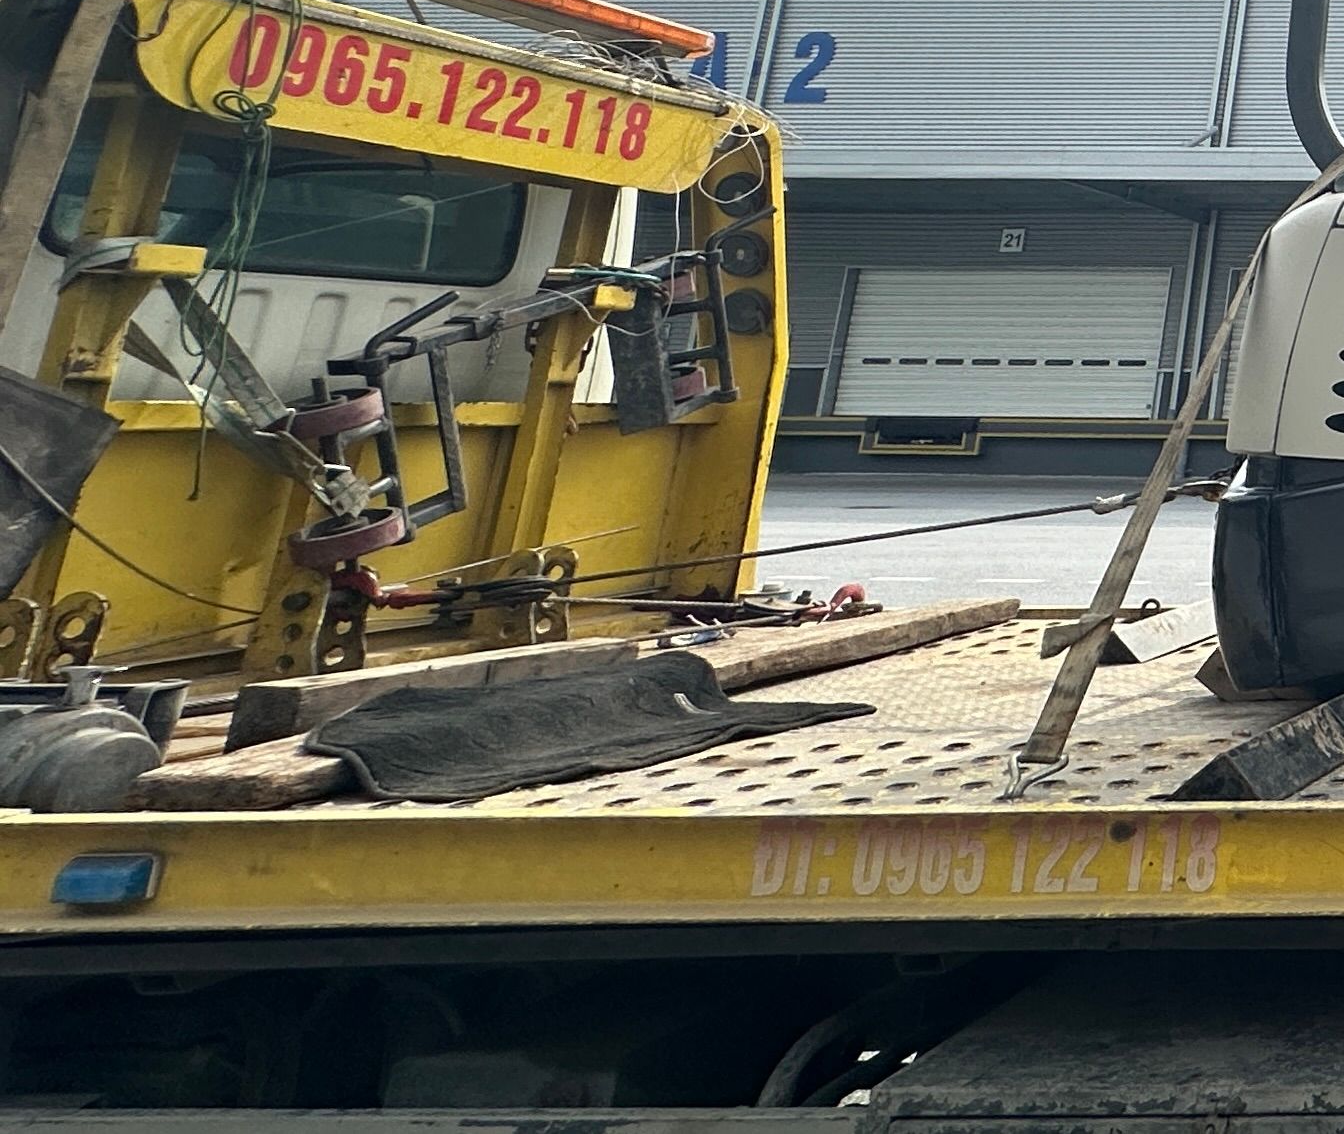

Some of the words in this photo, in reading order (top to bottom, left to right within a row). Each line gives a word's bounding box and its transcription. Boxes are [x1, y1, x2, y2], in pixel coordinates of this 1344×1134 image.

[228, 13, 652, 161] 0965.122.118
[783, 31, 837, 104] 2
[1003, 233, 1022, 248] 21
[852, 816, 991, 896] 0965
[1010, 815, 1105, 893] 122
[1118, 814, 1222, 893] 118
